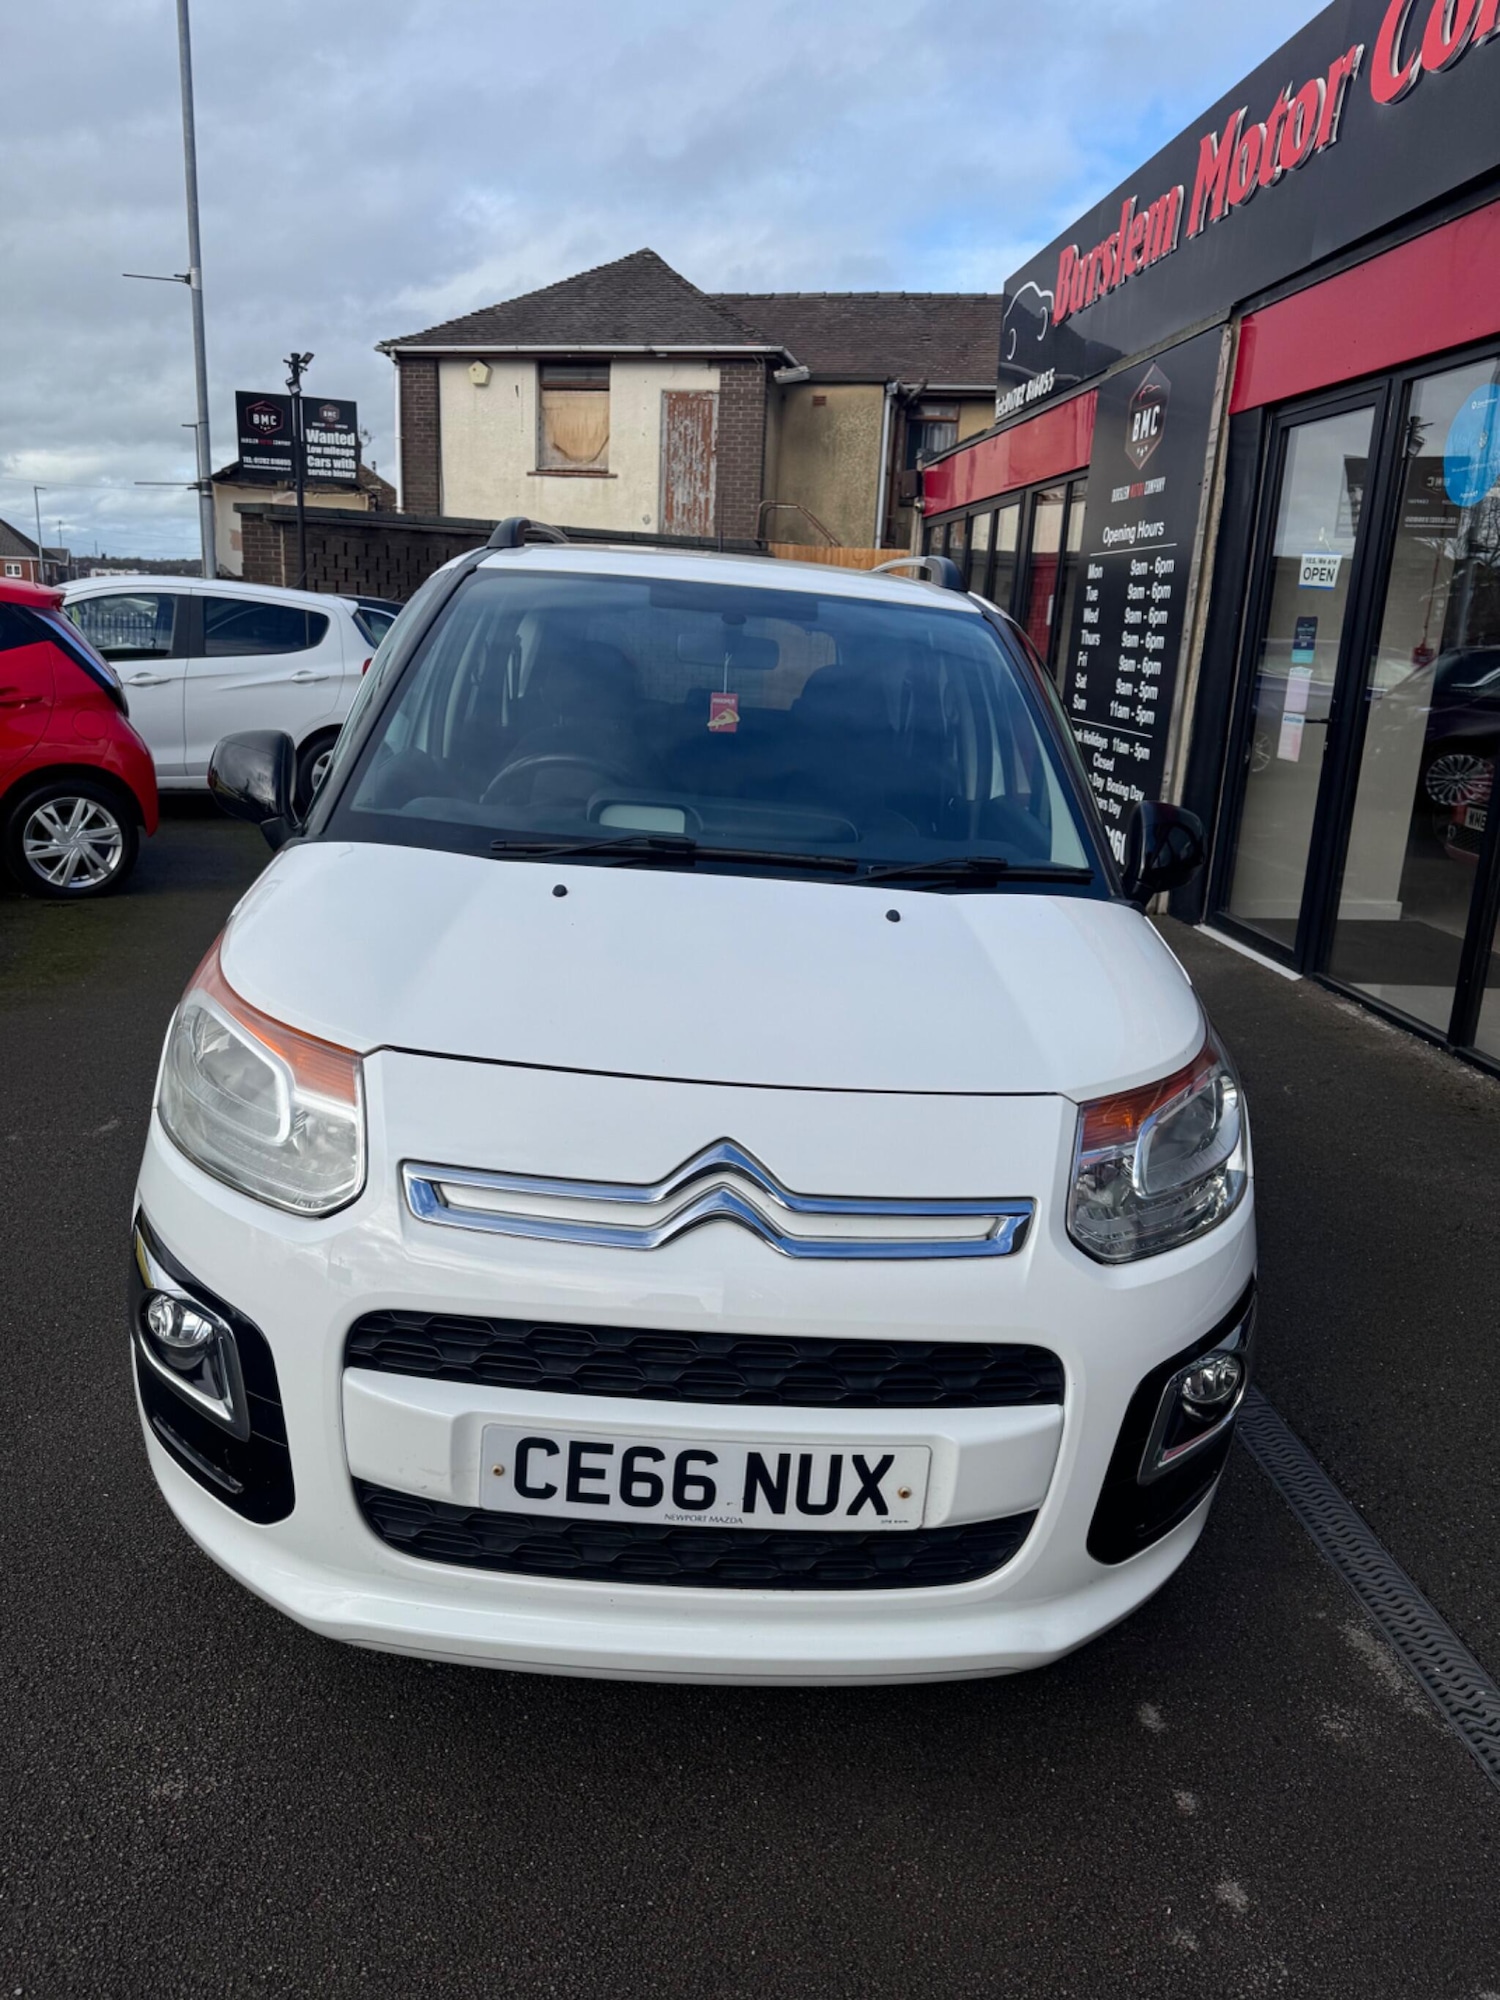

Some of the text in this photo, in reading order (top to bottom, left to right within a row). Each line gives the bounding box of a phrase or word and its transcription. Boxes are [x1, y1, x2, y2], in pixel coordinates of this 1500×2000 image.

[1051, 185, 1184, 327] Burslem
[1186, 43, 1365, 240] Motor
[253, 413, 277, 425] BMC
[1132, 405, 1160, 442] BMC
[305, 428, 355, 446] Wanted
[306, 444, 355, 457] Low mileage
[307, 455, 356, 470] Cars with
[307, 468, 357, 479] service history
[1103, 520, 1164, 547] Opening Hours
[1087, 563, 1104, 580] Mon
[1130, 559, 1148, 576] 9am
[1155, 556, 1175, 578] 6pm
[1303, 566, 1336, 582] OPEN
[1086, 585, 1099, 602] Tue
[1127, 583, 1145, 600] 9am
[1151, 581, 1171, 603] 6pm
[1083, 607, 1100, 623] Wed
[1124, 606, 1142, 624] 9am
[1148, 606, 1168, 629] 6pm
[1081, 629, 1101, 646] Thurs
[1121, 630, 1139, 648] 9am
[1145, 631, 1165, 653] 6pm
[1077, 651, 1088, 667] Fri
[1118, 654, 1136, 672] 9am
[1142, 656, 1162, 678] 6pm
[1075, 672, 1087, 689] Sat
[1115, 678, 1133, 696] 9am
[1138, 681, 1158, 702] 5pm
[1072, 693, 1087, 711] Sun
[1110, 700, 1130, 719] 11am
[1135, 704, 1155, 726] 5pm
[1083, 730, 1108, 751] Holidays
[1113, 737, 1130, 755] 11am
[1134, 742, 1150, 762] 5pm
[1093, 752, 1115, 772] Closed
[1093, 772, 1105, 792] Day
[1106, 777, 1129, 801] Boxing
[1129, 784, 1145, 801] Day
[1108, 798, 1122, 819] Day
[513, 1436, 896, 1517] CE66 NUX
[664, 1513, 744, 1524] NEWPORT MAZDA
